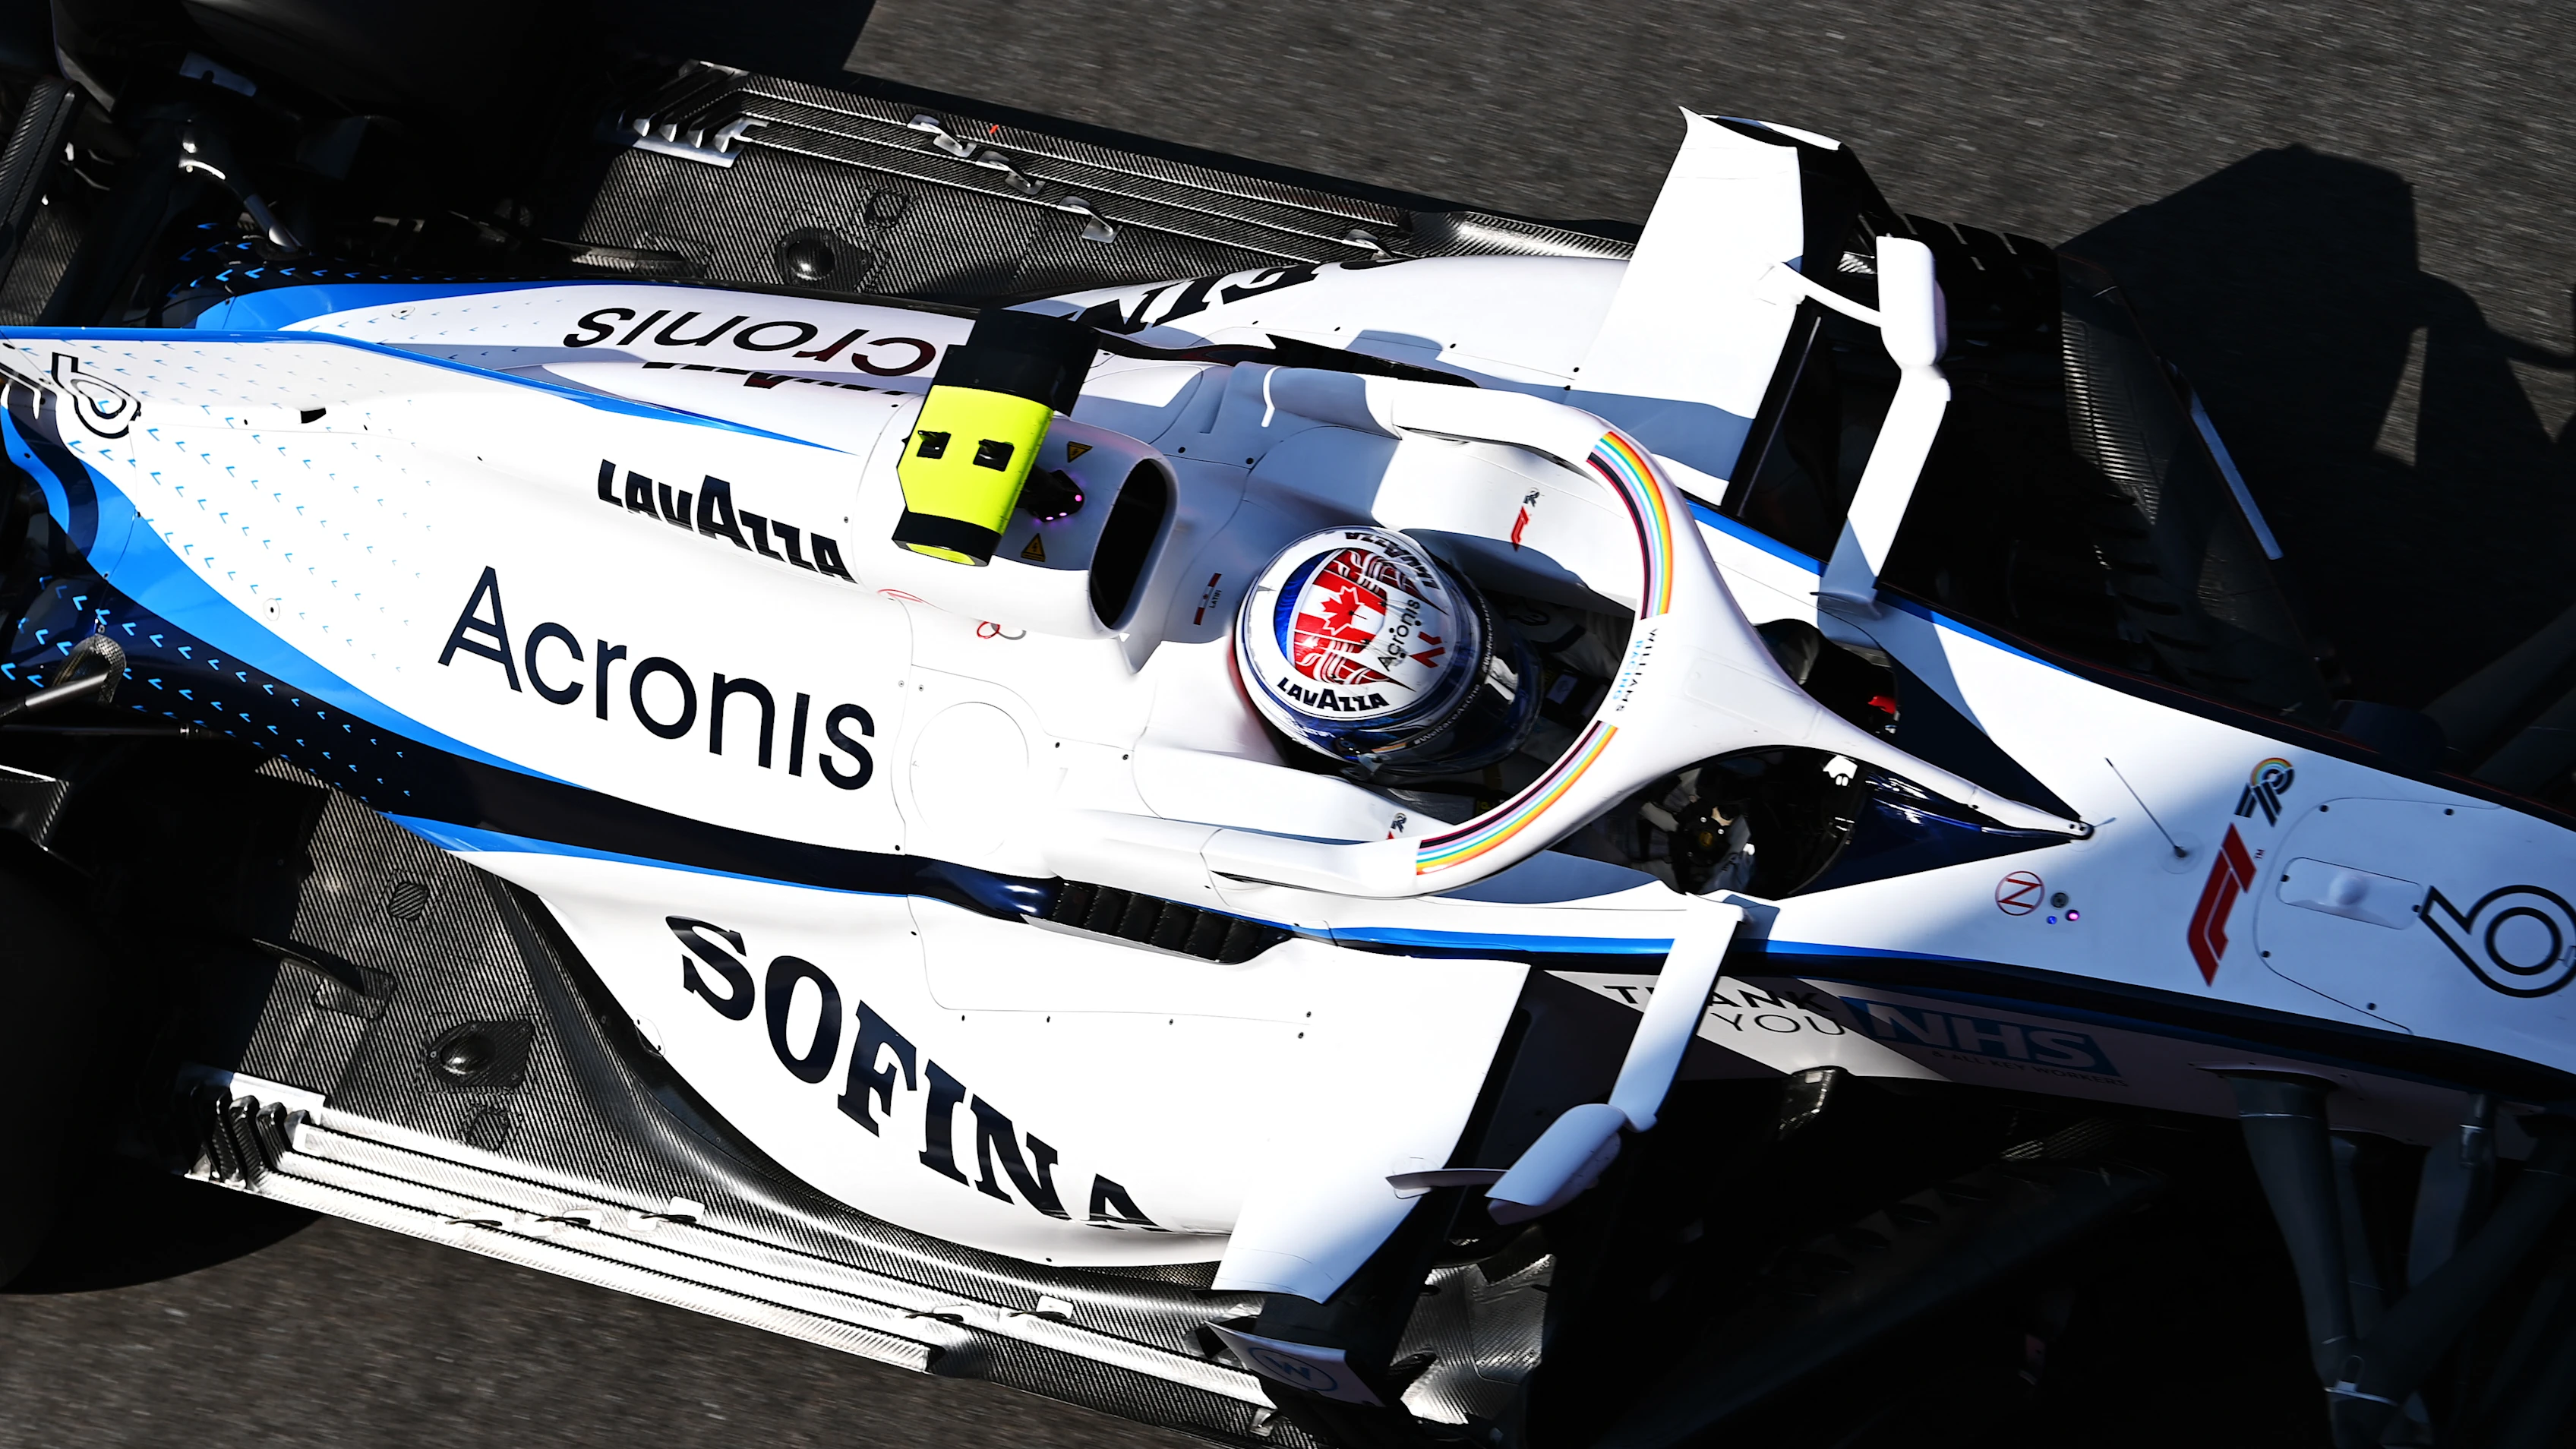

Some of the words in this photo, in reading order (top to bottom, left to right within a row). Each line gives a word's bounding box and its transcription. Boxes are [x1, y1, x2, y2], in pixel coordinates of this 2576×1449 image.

[563, 308, 936, 377] cronis
[51, 352, 141, 439] 6
[598, 459, 859, 583] LAVAZZA
[1378, 598, 1420, 671] Acronis
[437, 566, 875, 791] Acronis
[1277, 677, 1390, 712] LAVAZZA
[2419, 884, 2576, 998] 6
[1602, 985, 1832, 1012] TANK
[1710, 1013, 1846, 1035] YOU
[1865, 1003, 2097, 1069] NHS
[1952, 1054, 1985, 1065] ALL
[1992, 1059, 2025, 1072] KEY
[2031, 1066, 2129, 1088] WORKERS
[665, 915, 1177, 1233] SOFINA
